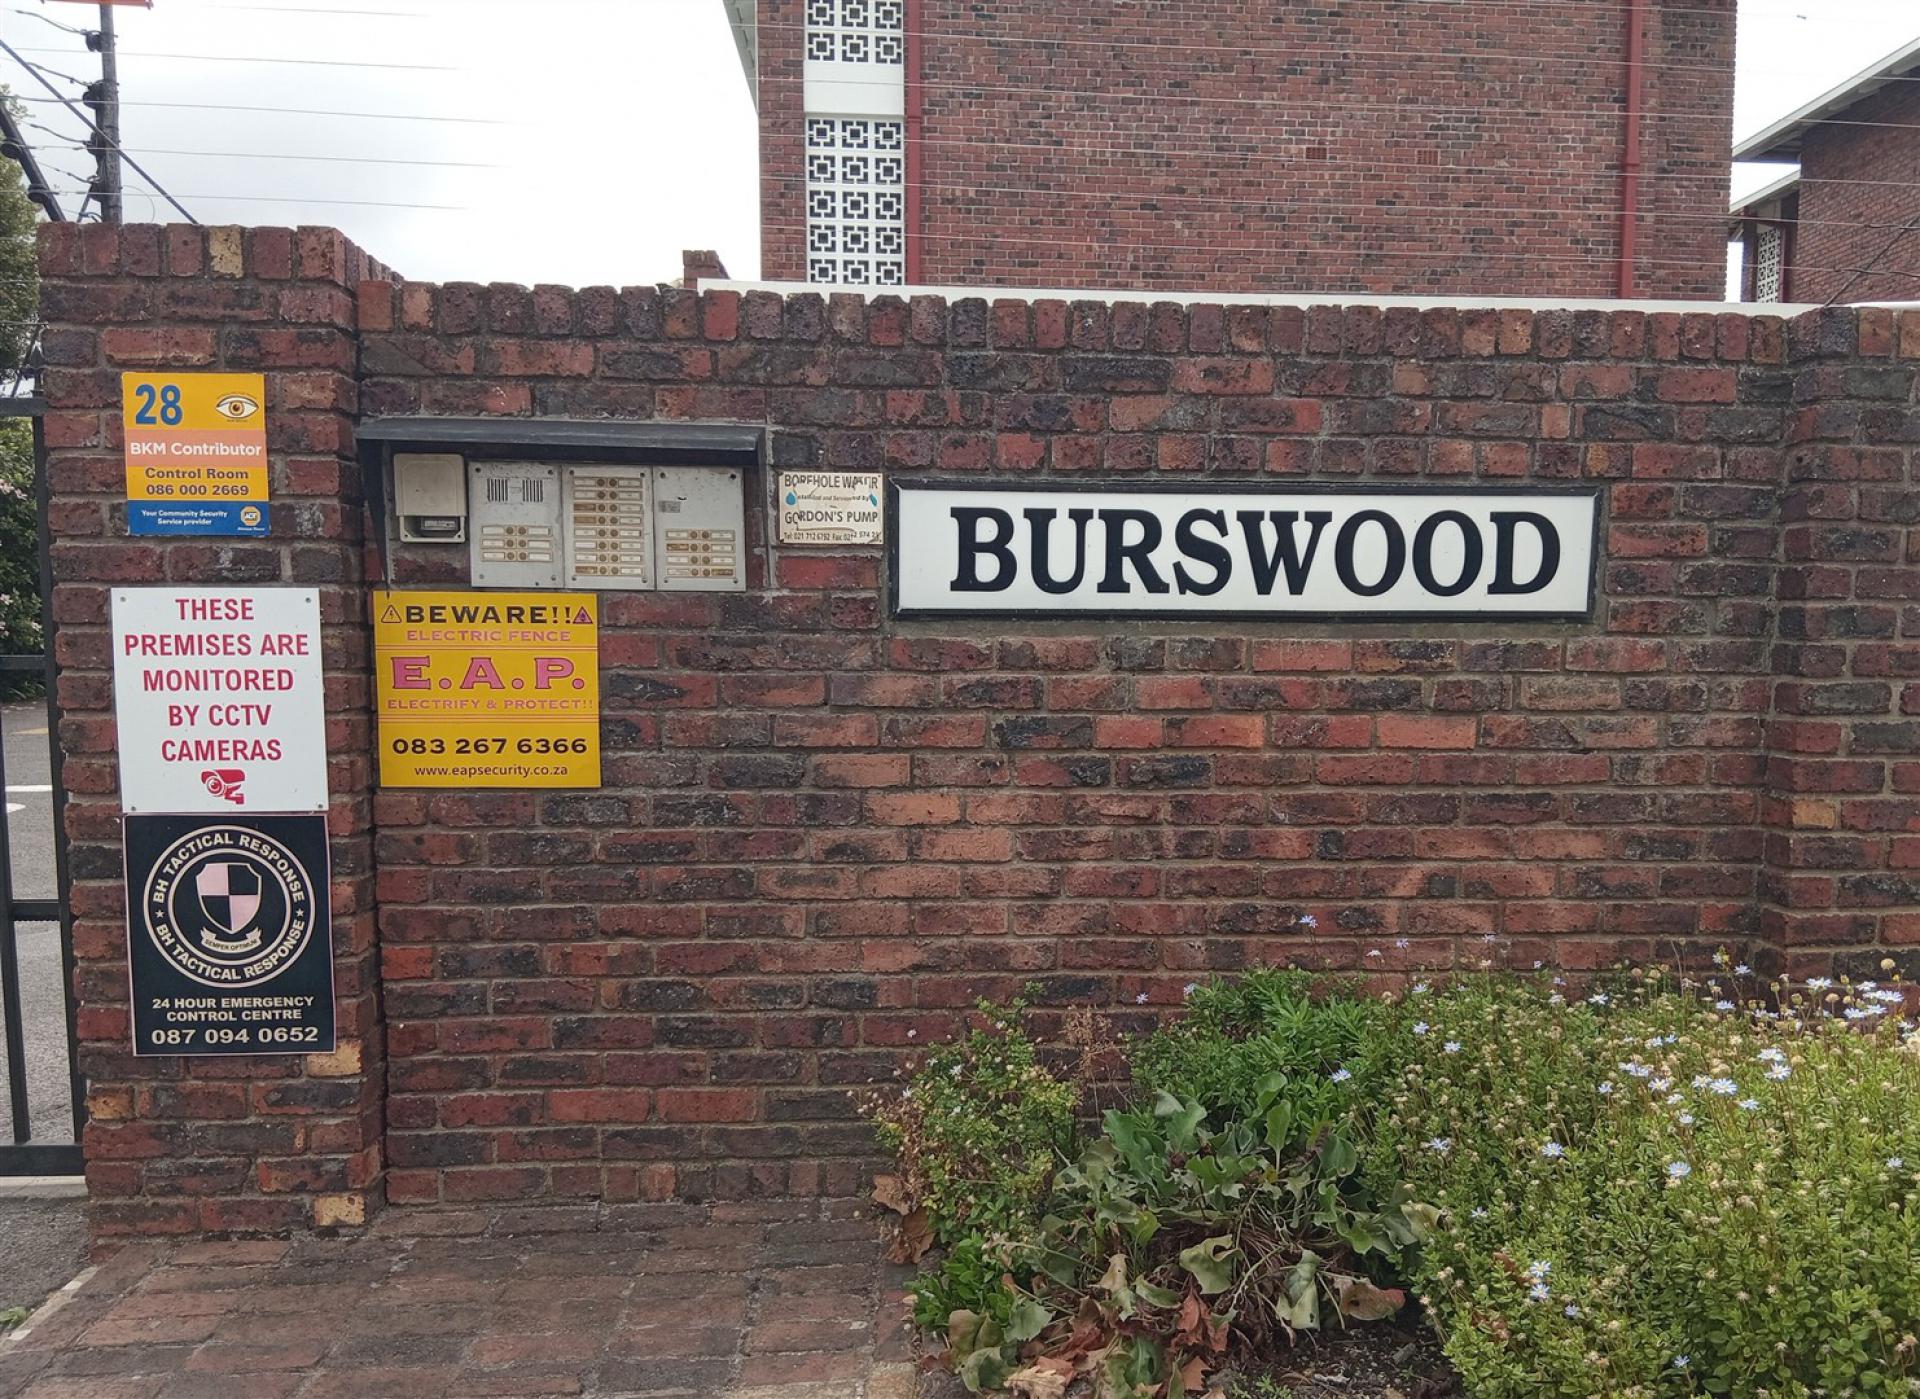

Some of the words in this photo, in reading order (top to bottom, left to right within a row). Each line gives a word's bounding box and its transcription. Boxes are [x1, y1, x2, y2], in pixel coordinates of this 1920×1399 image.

[136, 384, 183, 425] 28
[130, 443, 166, 455] BKM
[171, 442, 261, 455] Contributor
[145, 468, 201, 479] Control
[207, 469, 248, 479] Room
[784, 474, 840, 488] BOREHOLE
[146, 485, 174, 495] 086
[179, 485, 206, 495] 000
[212, 485, 249, 495] 2669
[159, 510, 198, 518] Community
[199, 510, 228, 518] Security
[784, 511, 843, 524] GORDON'S
[846, 512, 878, 523] PUMP
[184, 518, 212, 526] provider
[949, 507, 1561, 596] BURSWOOD
[176, 599, 255, 621] THESE
[406, 605, 571, 624] BEWARE!!
[407, 630, 502, 642] ELECTRIC
[509, 631, 570, 642] FENCE
[125, 634, 252, 656] PREMISES
[260, 634, 309, 656] ARE
[391, 655, 585, 689] E.A.P.
[144, 669, 294, 691] MONITORED
[387, 699, 480, 710] ELECTRIFY
[486, 700, 497, 709] &
[504, 699, 593, 709] PROTECT!!
[169, 704, 200, 726] BY
[209, 704, 272, 726] CCTV
[161, 739, 282, 762] CAMERAS
[392, 738, 446, 754] 083
[456, 738, 507, 754] 267
[516, 738, 588, 754] 6366
[414, 764, 568, 778] www.eapsecurity.co.za
[152, 878, 169, 904] BH
[163, 833, 233, 878] TACTICAL
[239, 835, 305, 903] RESPONSE
[155, 924, 176, 947] BH
[174, 946, 242, 980] TACTICAL
[244, 921, 306, 978] RESPONSE
[205, 939, 229, 950] SEMPER
[152, 998, 170, 1008] 24
[175, 998, 217, 1008] HOUR
[221, 996, 315, 1008] EMERGENCY
[166, 1010, 237, 1021] CONTROL
[242, 1009, 302, 1020] CENTRE
[151, 1029, 196, 1044] 087
[205, 1028, 250, 1044] 094
[258, 1027, 318, 1042] 0652
